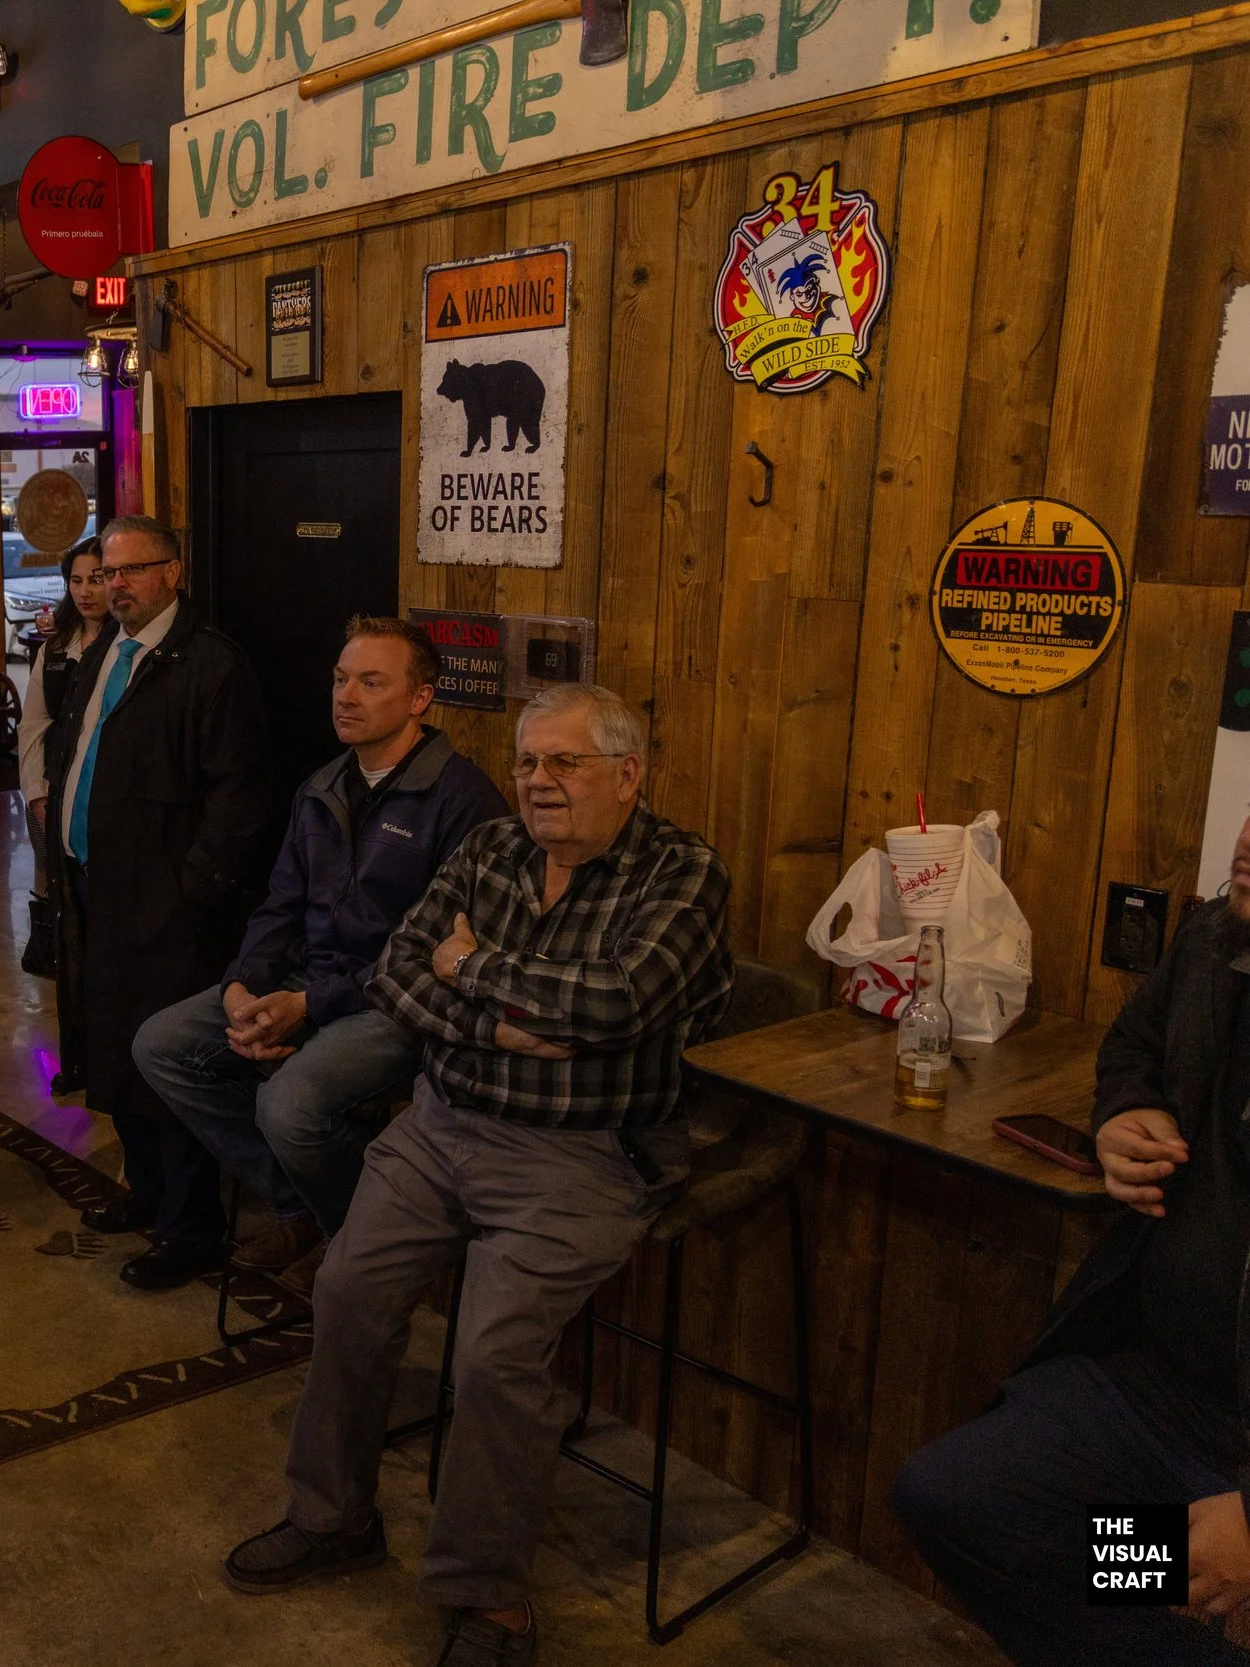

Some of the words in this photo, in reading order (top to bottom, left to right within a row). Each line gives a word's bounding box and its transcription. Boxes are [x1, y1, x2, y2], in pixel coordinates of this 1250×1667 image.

[187, 107, 329, 220] VOL.
[360, 21, 563, 179] FIRE
[764, 165, 842, 238] 34
[41, 230, 70, 239] Primero
[71, 229, 104, 240] pruébala
[96, 276, 127, 305] EXIT
[465, 277, 555, 325] WARNING
[733, 317, 760, 336] H.F.D.
[777, 322, 791, 333] on
[792, 320, 809, 334] the
[761, 345, 802, 374] WILD
[805, 336, 841, 359] SIDE
[804, 360, 827, 372] EST.
[830, 359, 851, 369] 1952
[440, 472, 541, 501] BEWARE
[431, 505, 462, 533] OF
[469, 505, 548, 534] BEARS
[963, 556, 1094, 589] WARNING
[941, 588, 1012, 612] REFINED
[1015, 592, 1113, 617] PRODUCTS
[420, 619, 500, 648] ARCASM
[981, 611, 1063, 636] PIPELINE
[950, 630, 979, 640] BEFORE
[979, 631, 1025, 643] EXCAVATING
[1025, 635, 1036, 643] OR
[1037, 636, 1046, 644] IN
[1046, 637, 1094, 648] EMERGENCY
[972, 643, 989, 652] Call
[997, 645, 1065, 659] 1-800-537-5200
[447, 656, 468, 671] THE
[966, 658, 1005, 669] ExxonMobil
[1035, 664, 1068, 676] Company
[459, 678, 463, 691] I
[1019, 677, 1037, 685] Texas
[894, 862, 949, 894] hick-fil-A
